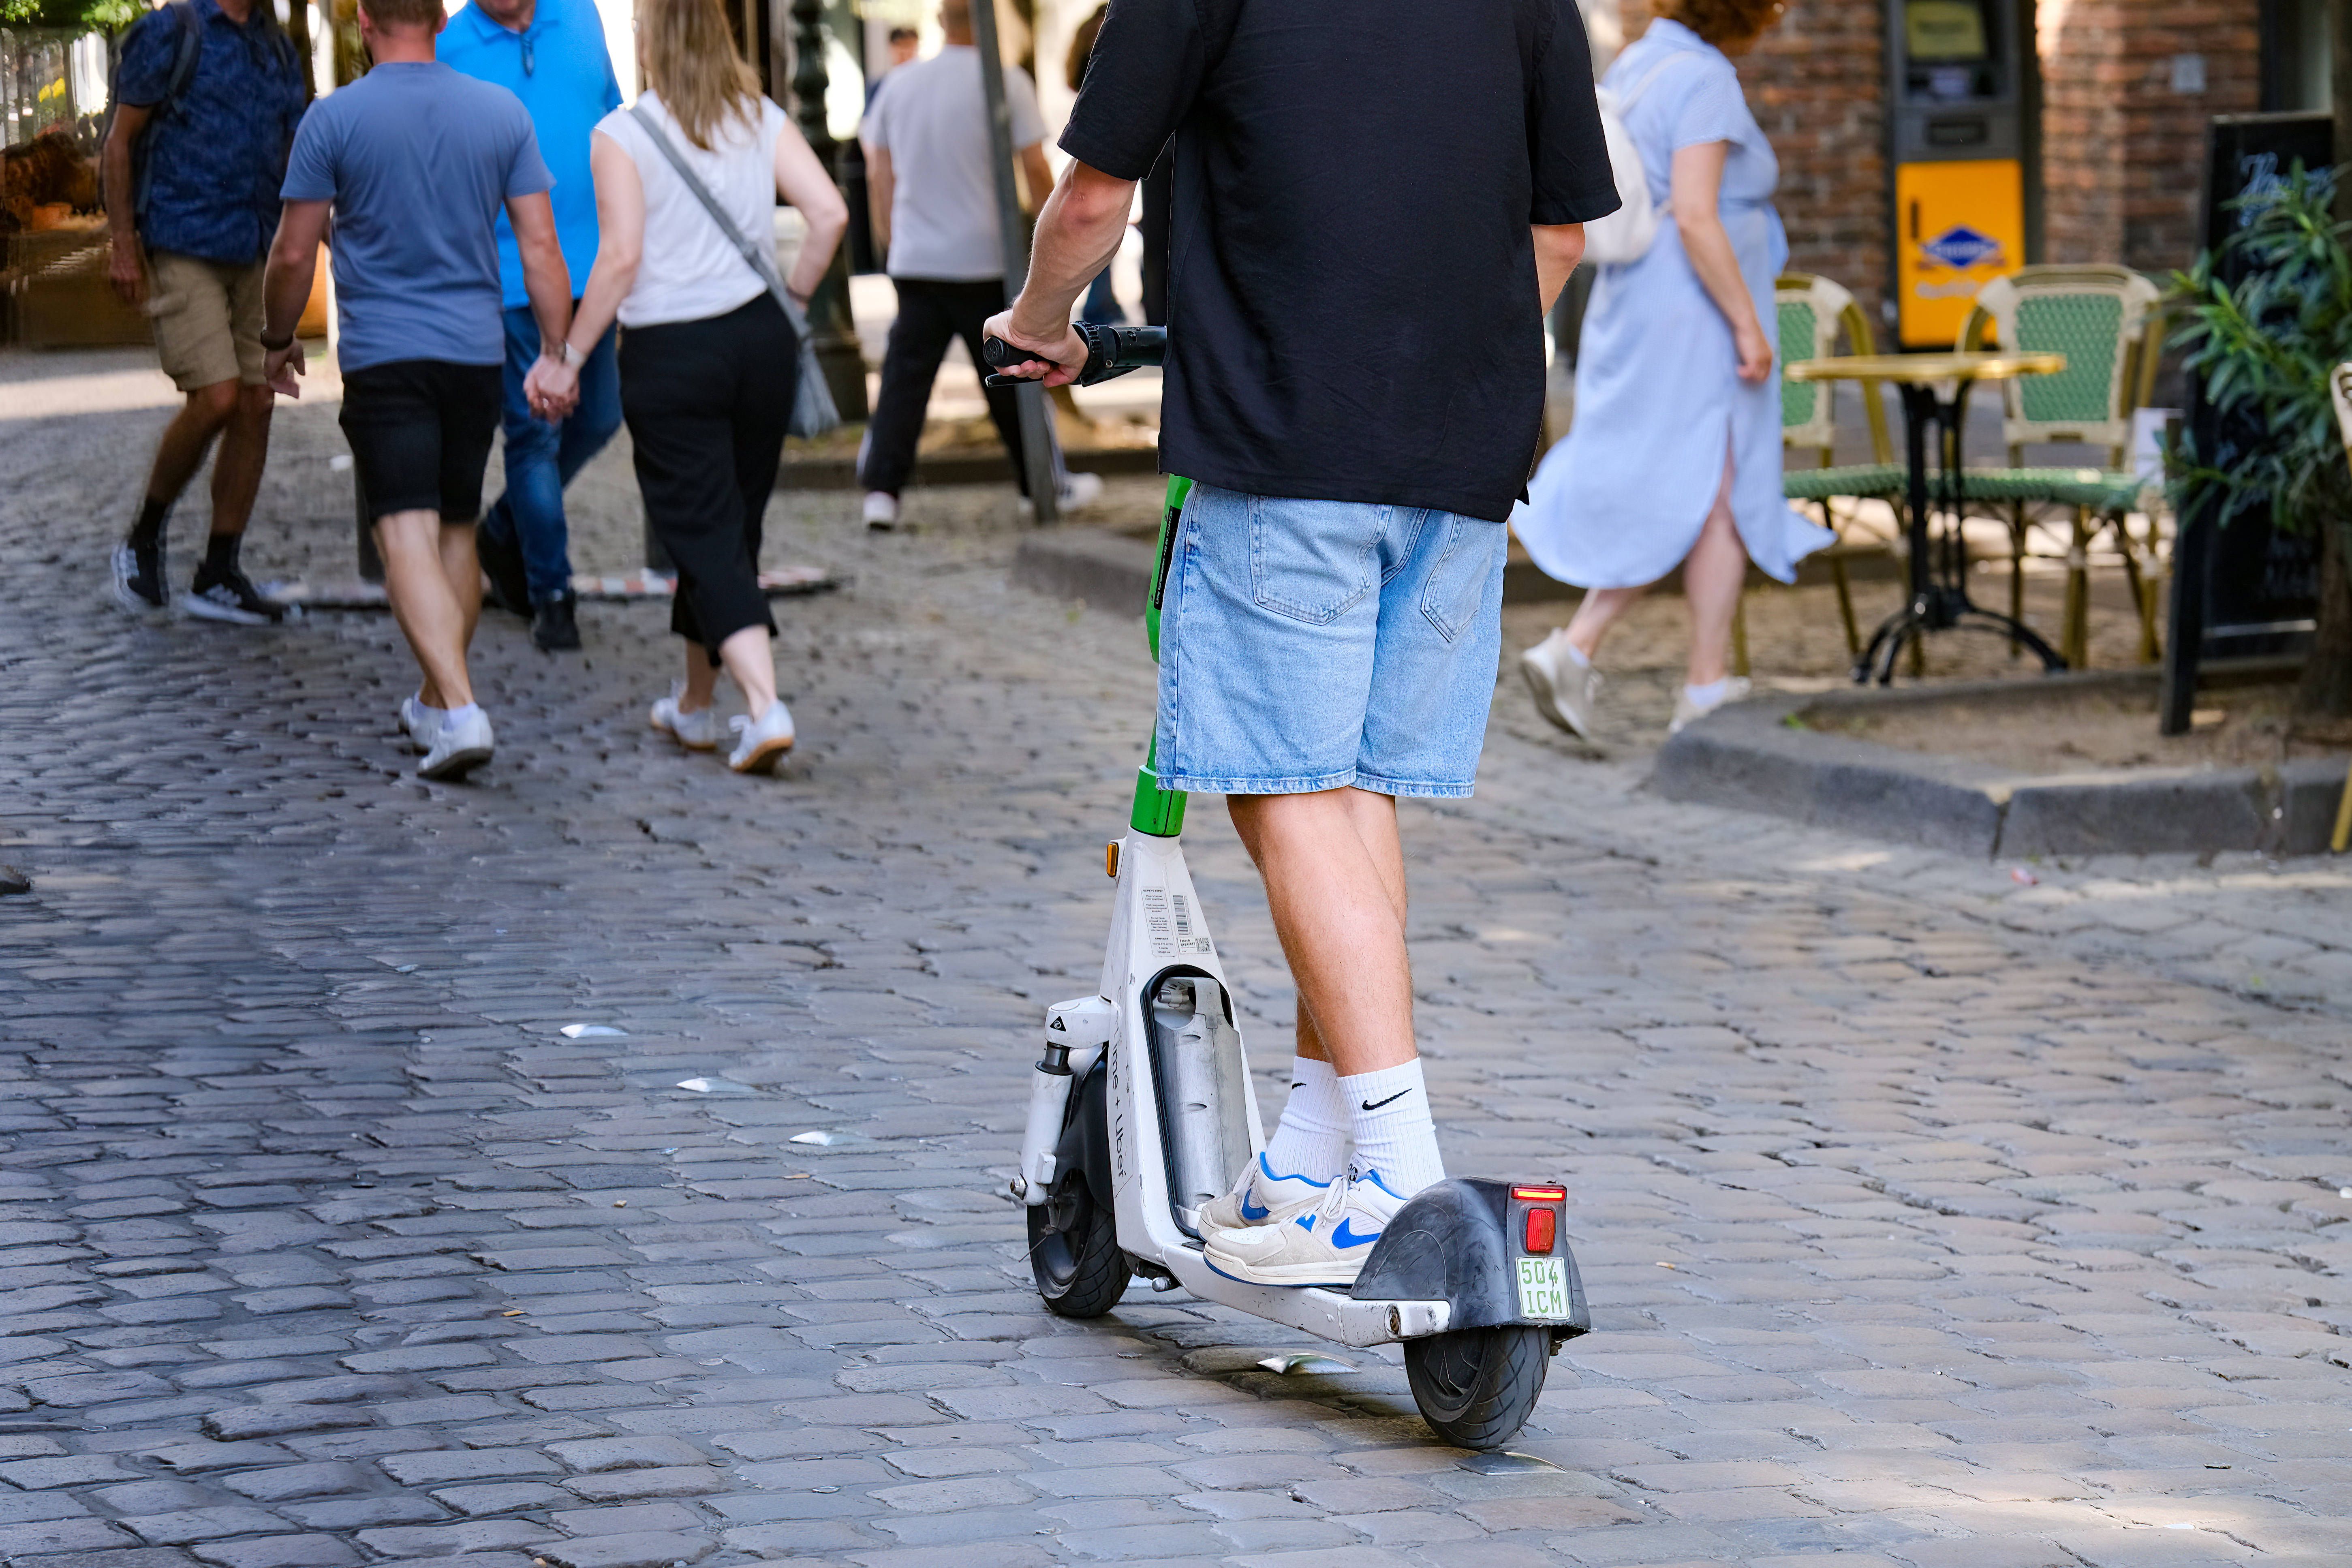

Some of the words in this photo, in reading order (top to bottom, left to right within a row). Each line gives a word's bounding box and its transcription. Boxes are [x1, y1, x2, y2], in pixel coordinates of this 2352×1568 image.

[1116, 1114, 1124, 1177] Uber
[1521, 1261, 1558, 1284] 504
[1527, 1291, 1562, 1314] ICM
